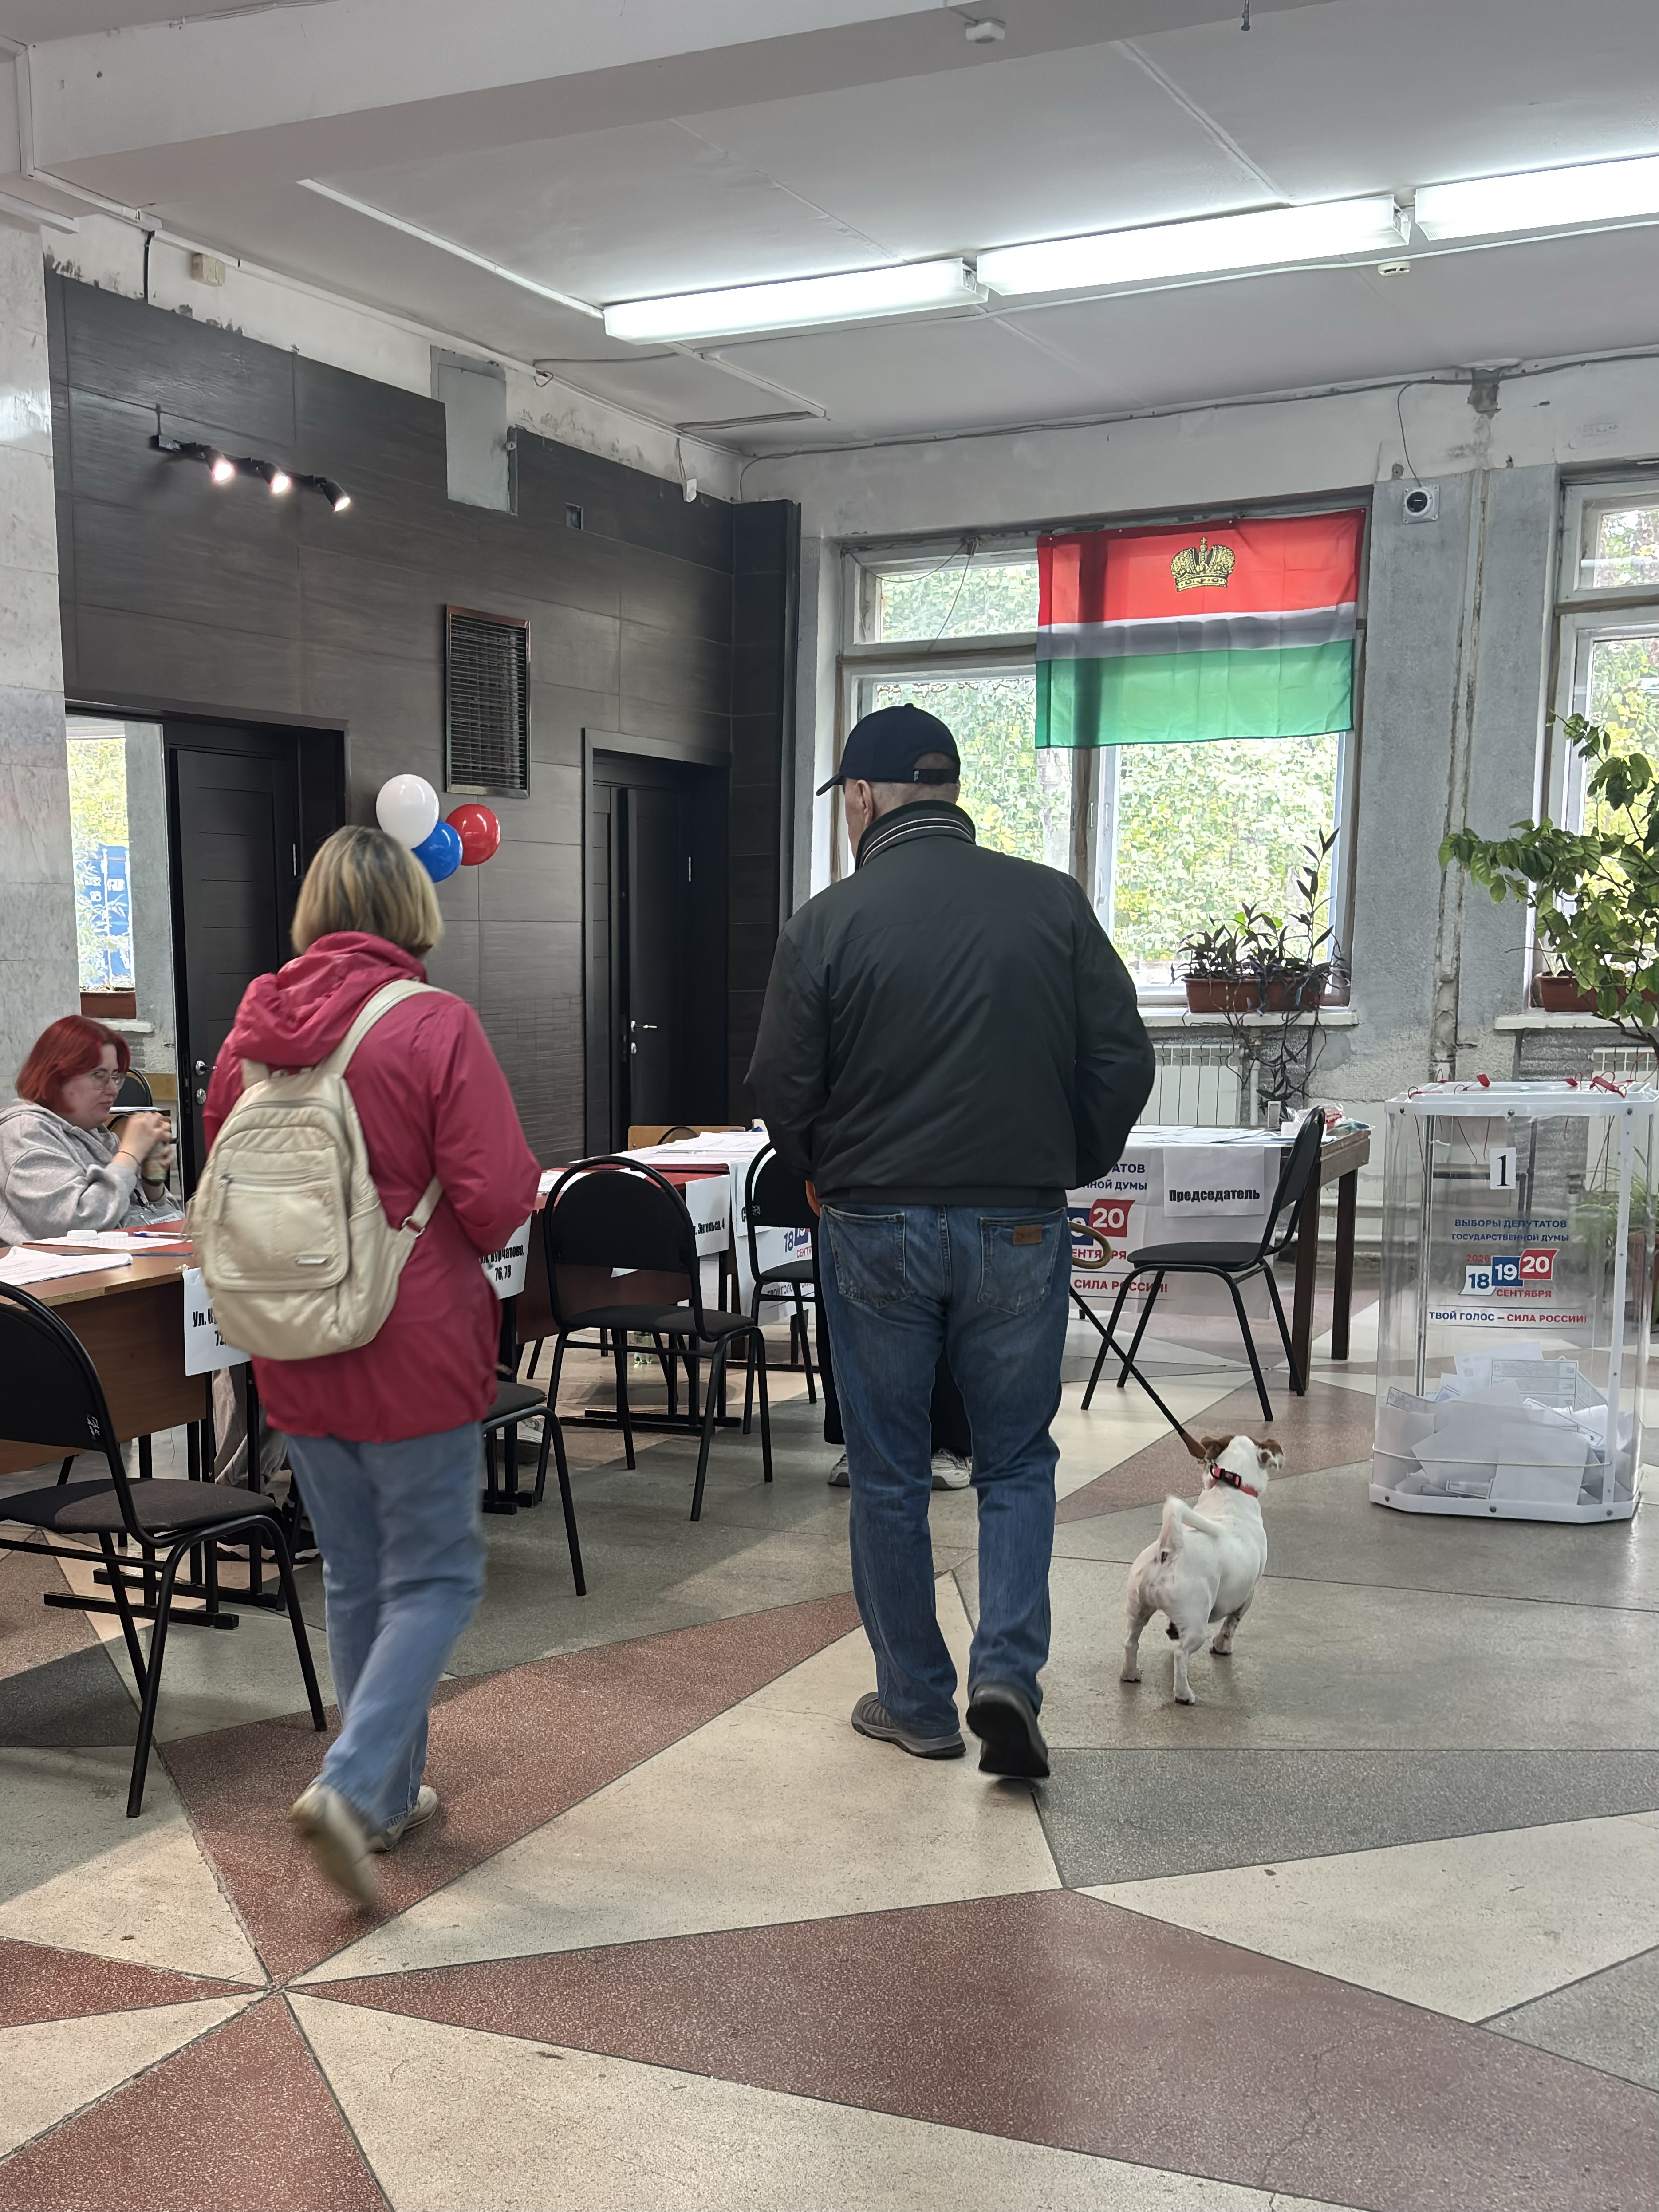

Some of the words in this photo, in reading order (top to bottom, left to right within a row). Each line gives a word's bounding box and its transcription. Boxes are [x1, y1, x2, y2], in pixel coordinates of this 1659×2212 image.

[1497, 1155, 1510, 1187] 1
[1115, 1182, 1147, 1191] ДУМЫ
[1169, 1190, 1260, 1202] Председатель
[1092, 1207, 1125, 1228] 20
[722, 1218, 725, 1229] 4
[1455, 1219, 1501, 1228] ВЫБОРЫ
[1504, 1220, 1567, 1229] ДЕПУТАТОВ
[784, 1231, 793, 1253] 18
[1452, 1233, 1539, 1241] ГОСУДАРСТВЕННОЙ
[504, 1265, 511, 1279] 78
[1468, 1273, 1490, 1289] 18
[1495, 1264, 1517, 1281] 19
[1522, 1256, 1550, 1273] 20
[1074, 1279, 1108, 1289] СИЛА
[1496, 1289, 1552, 1298] СЕНТЯБРЯ
[193, 1311, 207, 1328] Ул.
[1429, 1311, 1457, 1320] ТВОЙ
[1460, 1313, 1495, 1321] ГОЛОС
[1507, 1314, 1536, 1322] СИЛА
